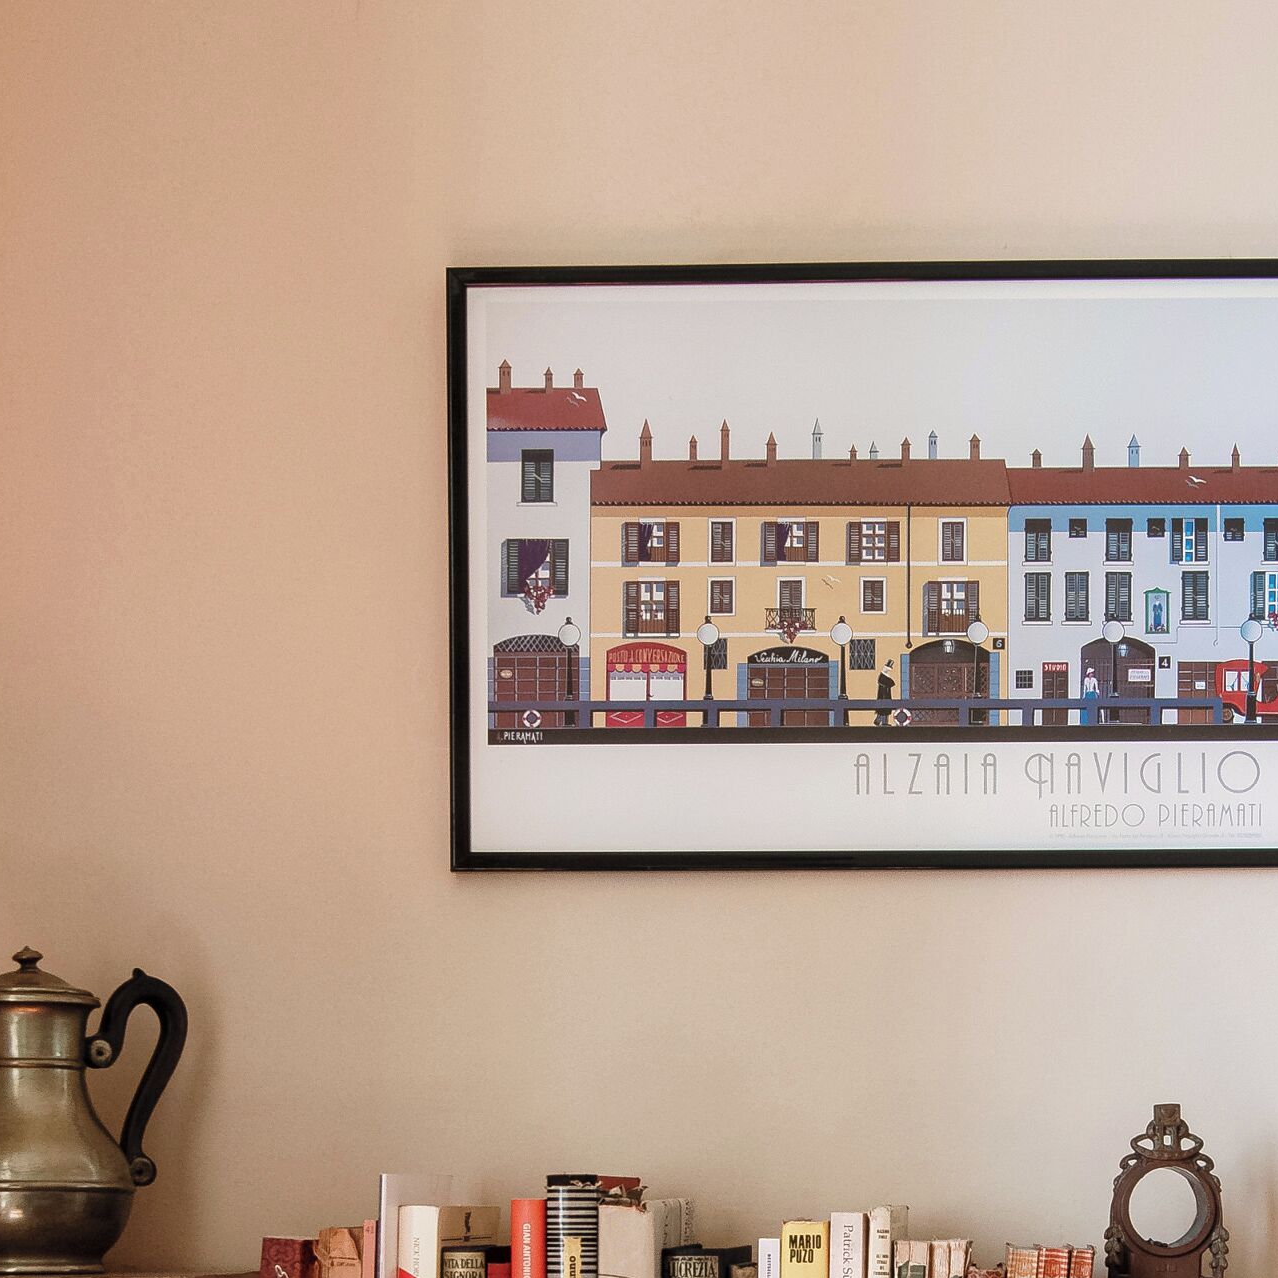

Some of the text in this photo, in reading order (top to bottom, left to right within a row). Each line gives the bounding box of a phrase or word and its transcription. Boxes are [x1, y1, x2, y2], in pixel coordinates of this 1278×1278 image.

[995, 639, 1003, 648] 6
[786, 650, 823, 663] Milano
[1161, 657, 1169, 667] 4
[1044, 663, 1067, 672] STUDIO
[854, 753, 997, 795] ALZAIA
[1025, 751, 1261, 799] NAVIGLIO
[1050, 803, 1262, 827] ALFREDO PIERAMATI
[523, 1223, 532, 1244] GIAN
[789, 1235, 822, 1249] MARIO
[843, 1224, 854, 1265] Patrick
[789, 1249, 814, 1263] PUZO
[444, 1259, 485, 1269] VITA DELLA
[669, 1261, 716, 1278] LUCREZIA
